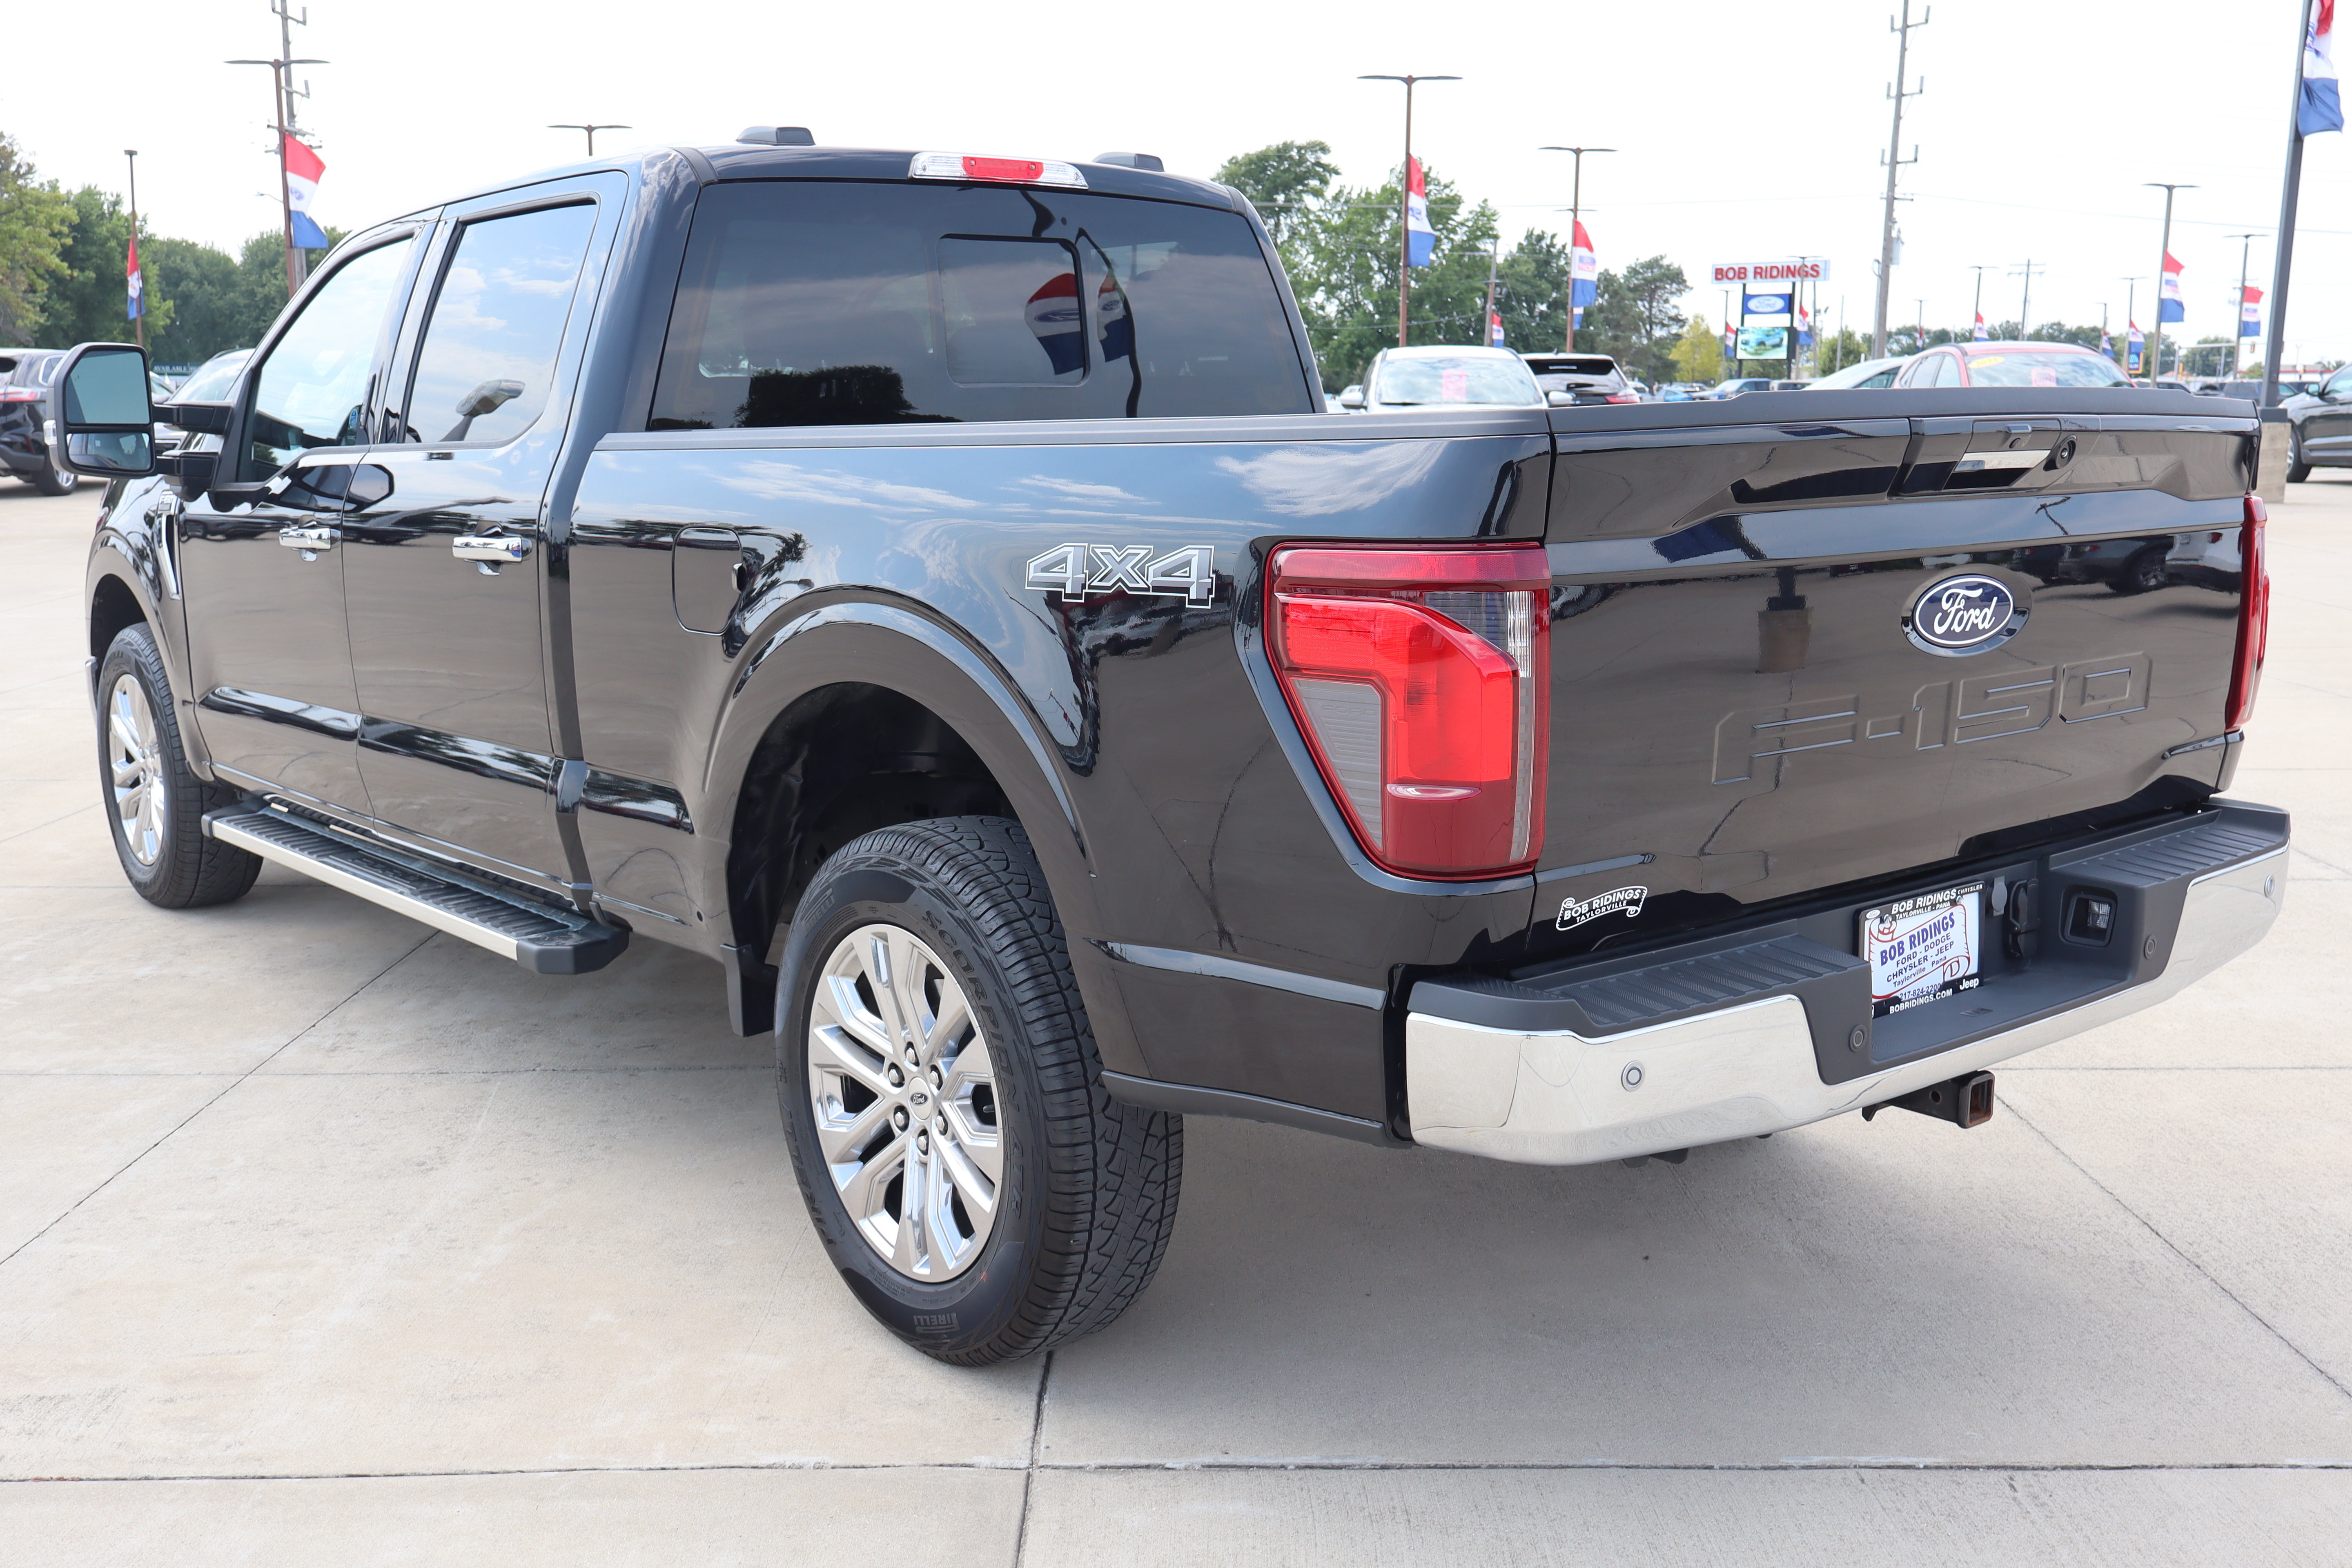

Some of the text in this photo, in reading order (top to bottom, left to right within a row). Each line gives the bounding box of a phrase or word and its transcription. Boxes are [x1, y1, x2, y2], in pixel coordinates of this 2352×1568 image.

[1715, 264, 1820, 281] BOB RIDINGS
[1933, 588, 1998, 634] Ford
[1712, 652, 2152, 785] F-150
[1564, 889, 1641, 920] BOB RIDINGS
[1576, 900, 1627, 923] TAYLORVILLE
[1891, 884, 1983, 915] BOB RIDINGS CHRYSLER
[1895, 907, 1931, 920] TAYLORVILLE
[1936, 901, 1950, 910] PANA
[1880, 912, 1955, 967] BOB RIDINGS
[1896, 951, 1917, 968] FORD
[1924, 932, 1951, 952] DODGE
[1887, 954, 1928, 982] CHRYSLER
[1936, 941, 1954, 957] JEEP
[1893, 955, 1947, 988] Taylorville Pana
[1900, 983, 1940, 1000] 217-824-2200
[1960, 978, 1979, 990] Jeep
[922, 910, 1019, 1112] SCORPION
[1890, 988, 1953, 1014] BOBRIDINGS.COM
[913, 1094, 925, 1104] Ford
[914, 1312, 960, 1334] PIRELLI
